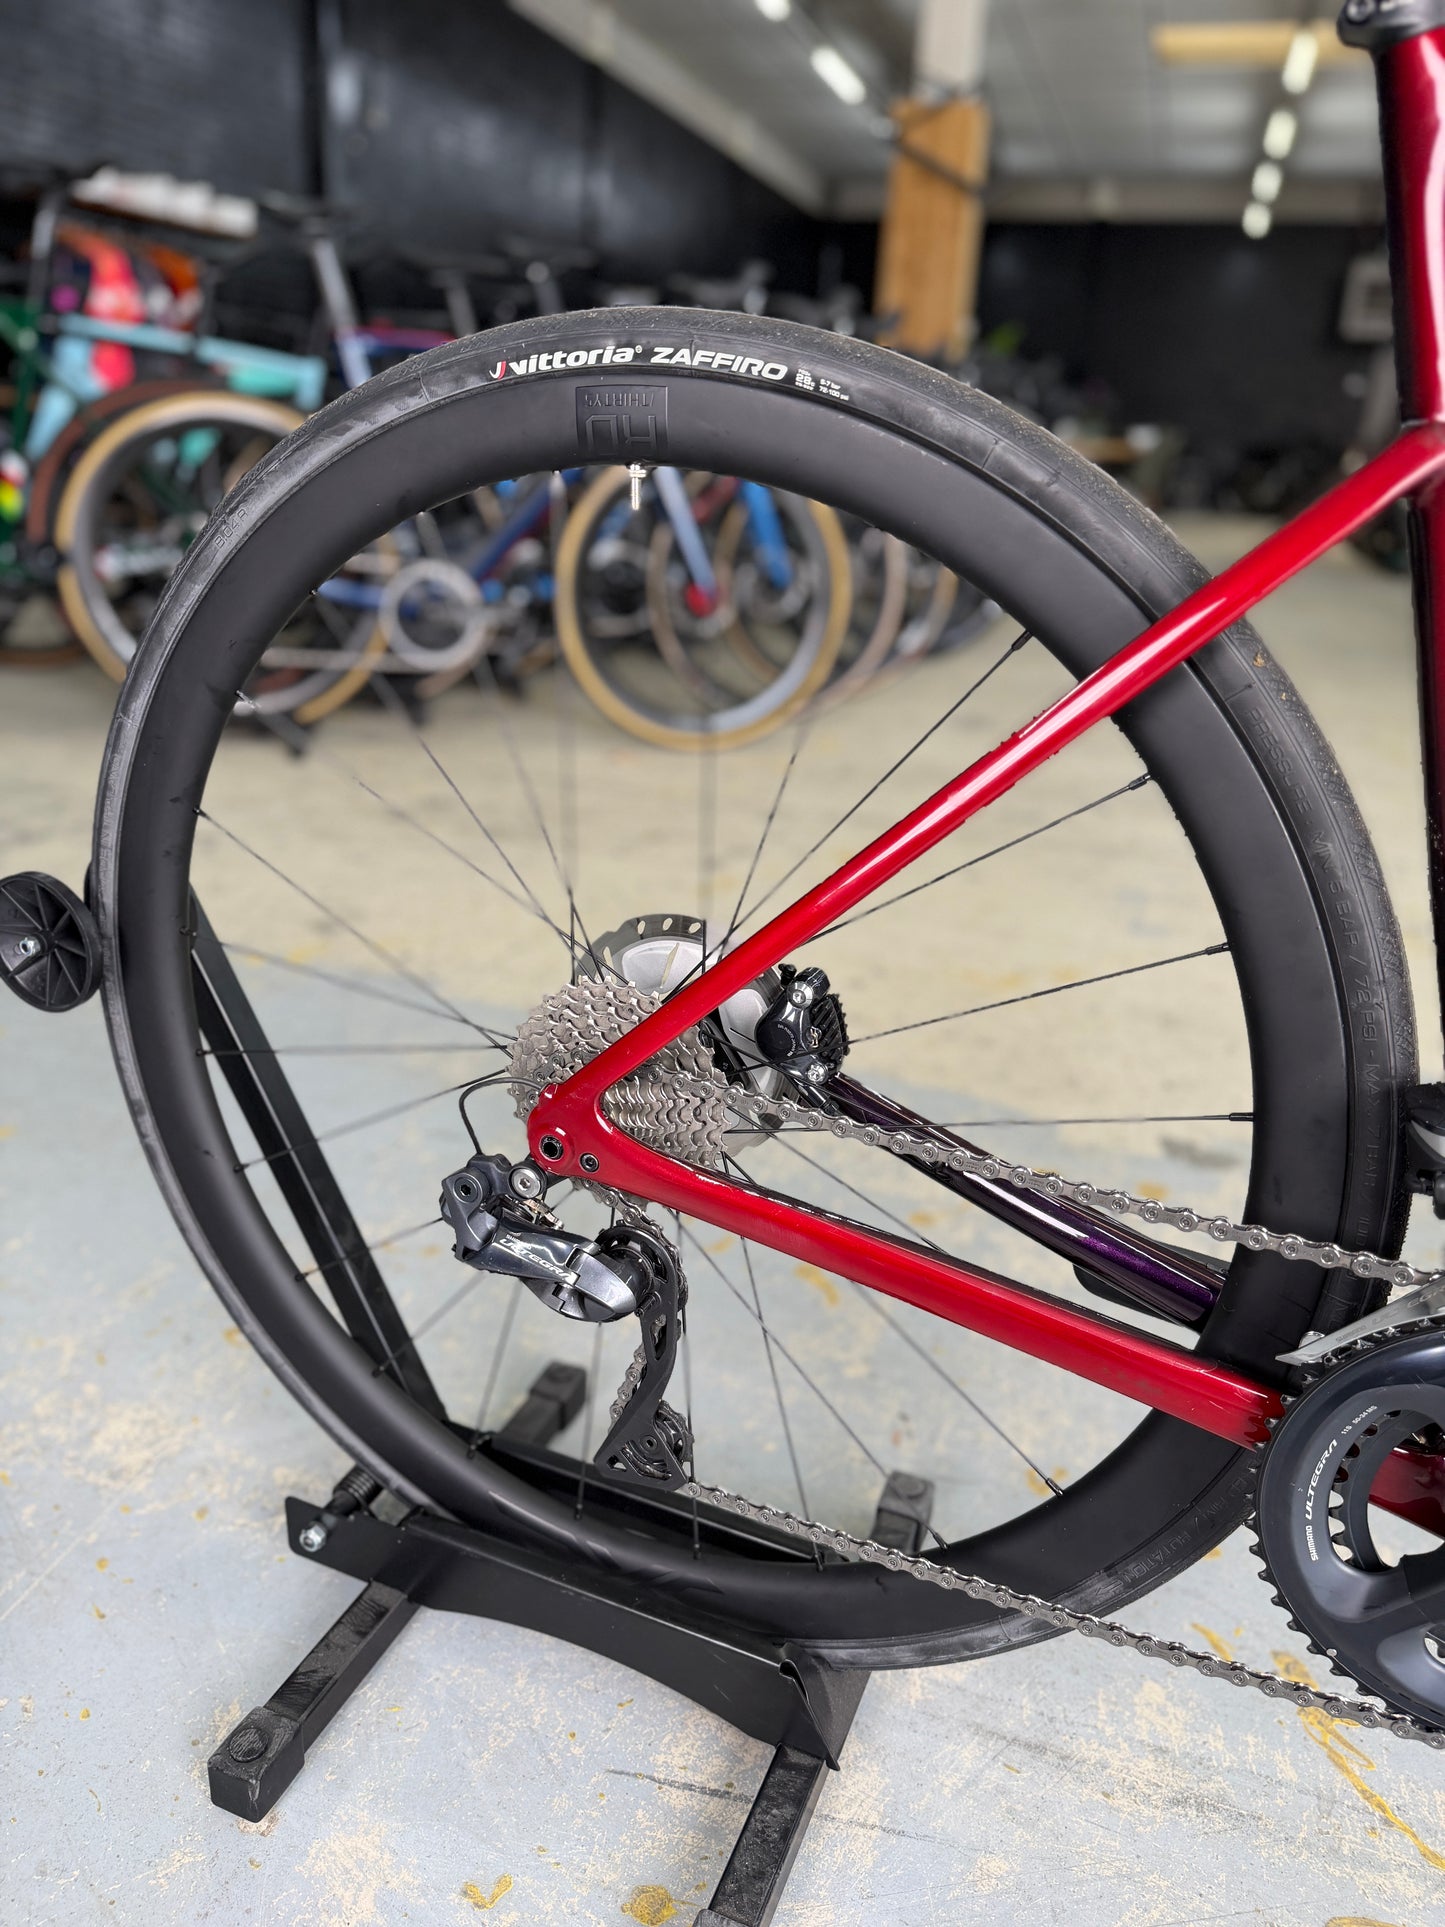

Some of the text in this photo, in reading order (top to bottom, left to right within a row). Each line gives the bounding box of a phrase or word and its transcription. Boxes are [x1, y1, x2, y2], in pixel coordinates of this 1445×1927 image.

[508, 344, 788, 381] vittoria ZAFFIRO
[1305, 1438, 1338, 1520] ULTEGRA
[1305, 1524, 1319, 1561] SHIMANO
